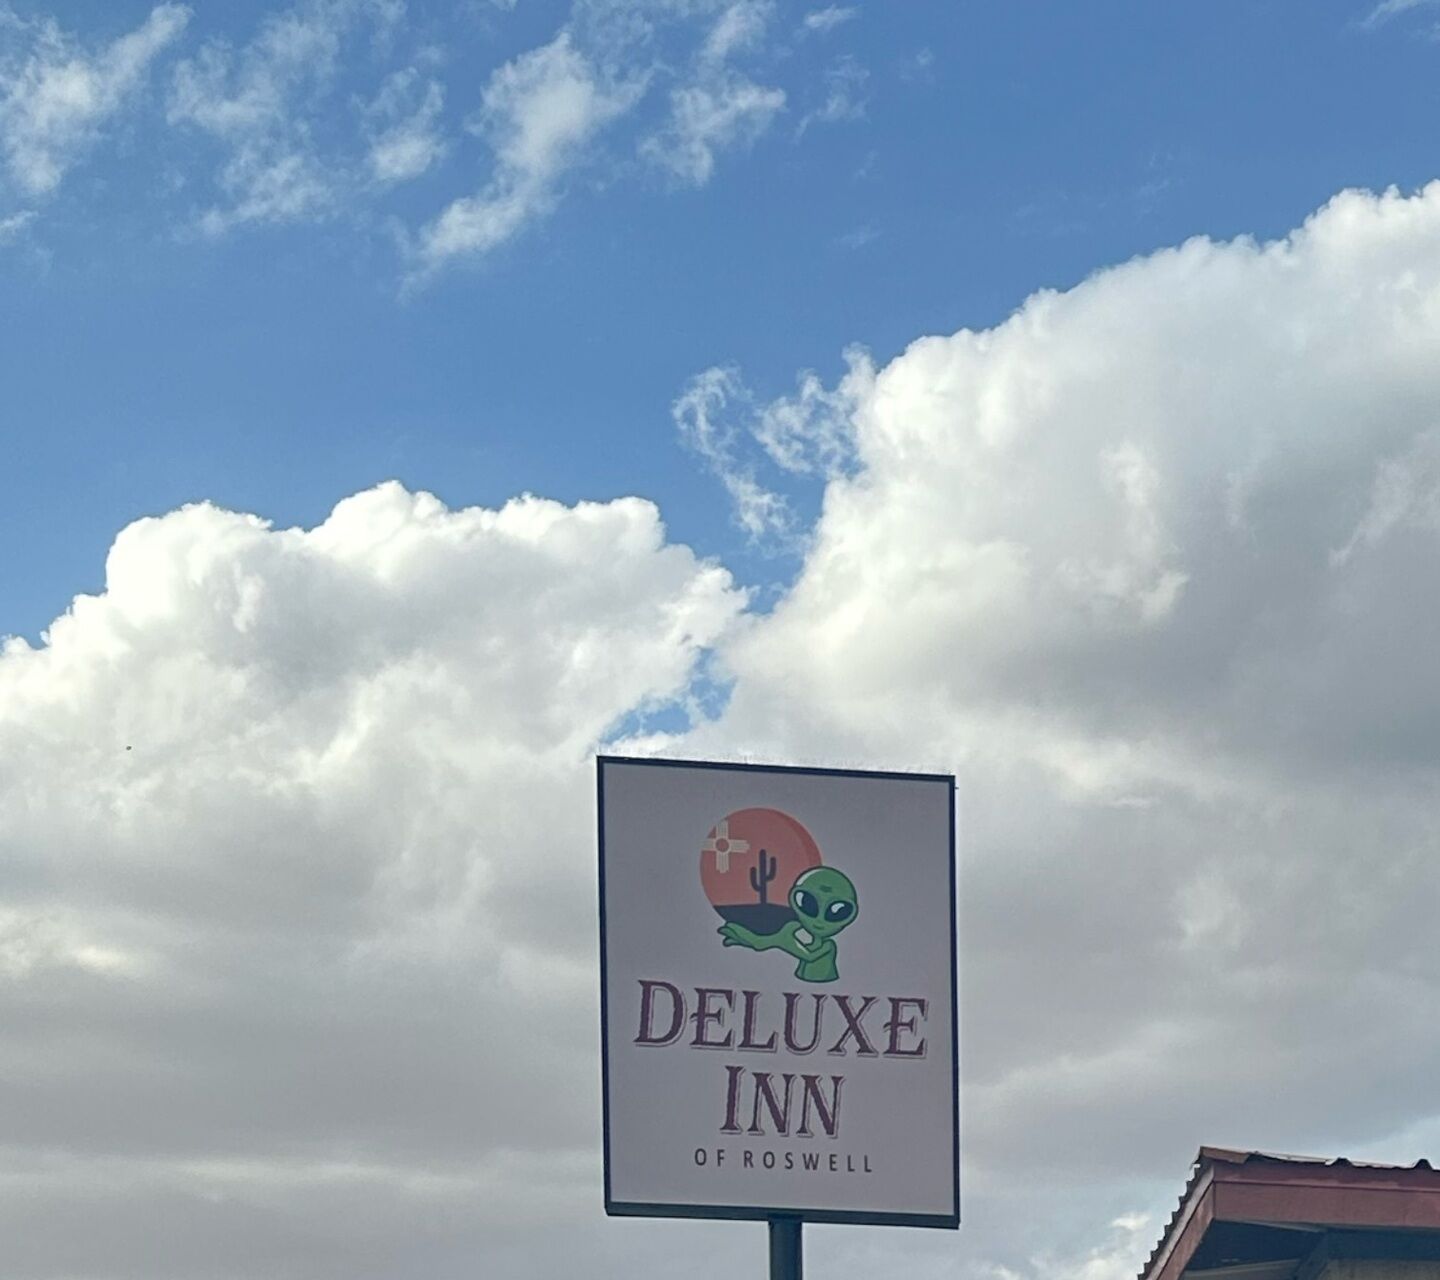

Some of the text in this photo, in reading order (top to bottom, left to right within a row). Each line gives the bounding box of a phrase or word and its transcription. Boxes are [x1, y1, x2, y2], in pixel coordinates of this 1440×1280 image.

[633, 979, 929, 1059] DELUXE
[719, 1065, 847, 1139] INN
[694, 1148, 872, 1173] OF ROSWELL
